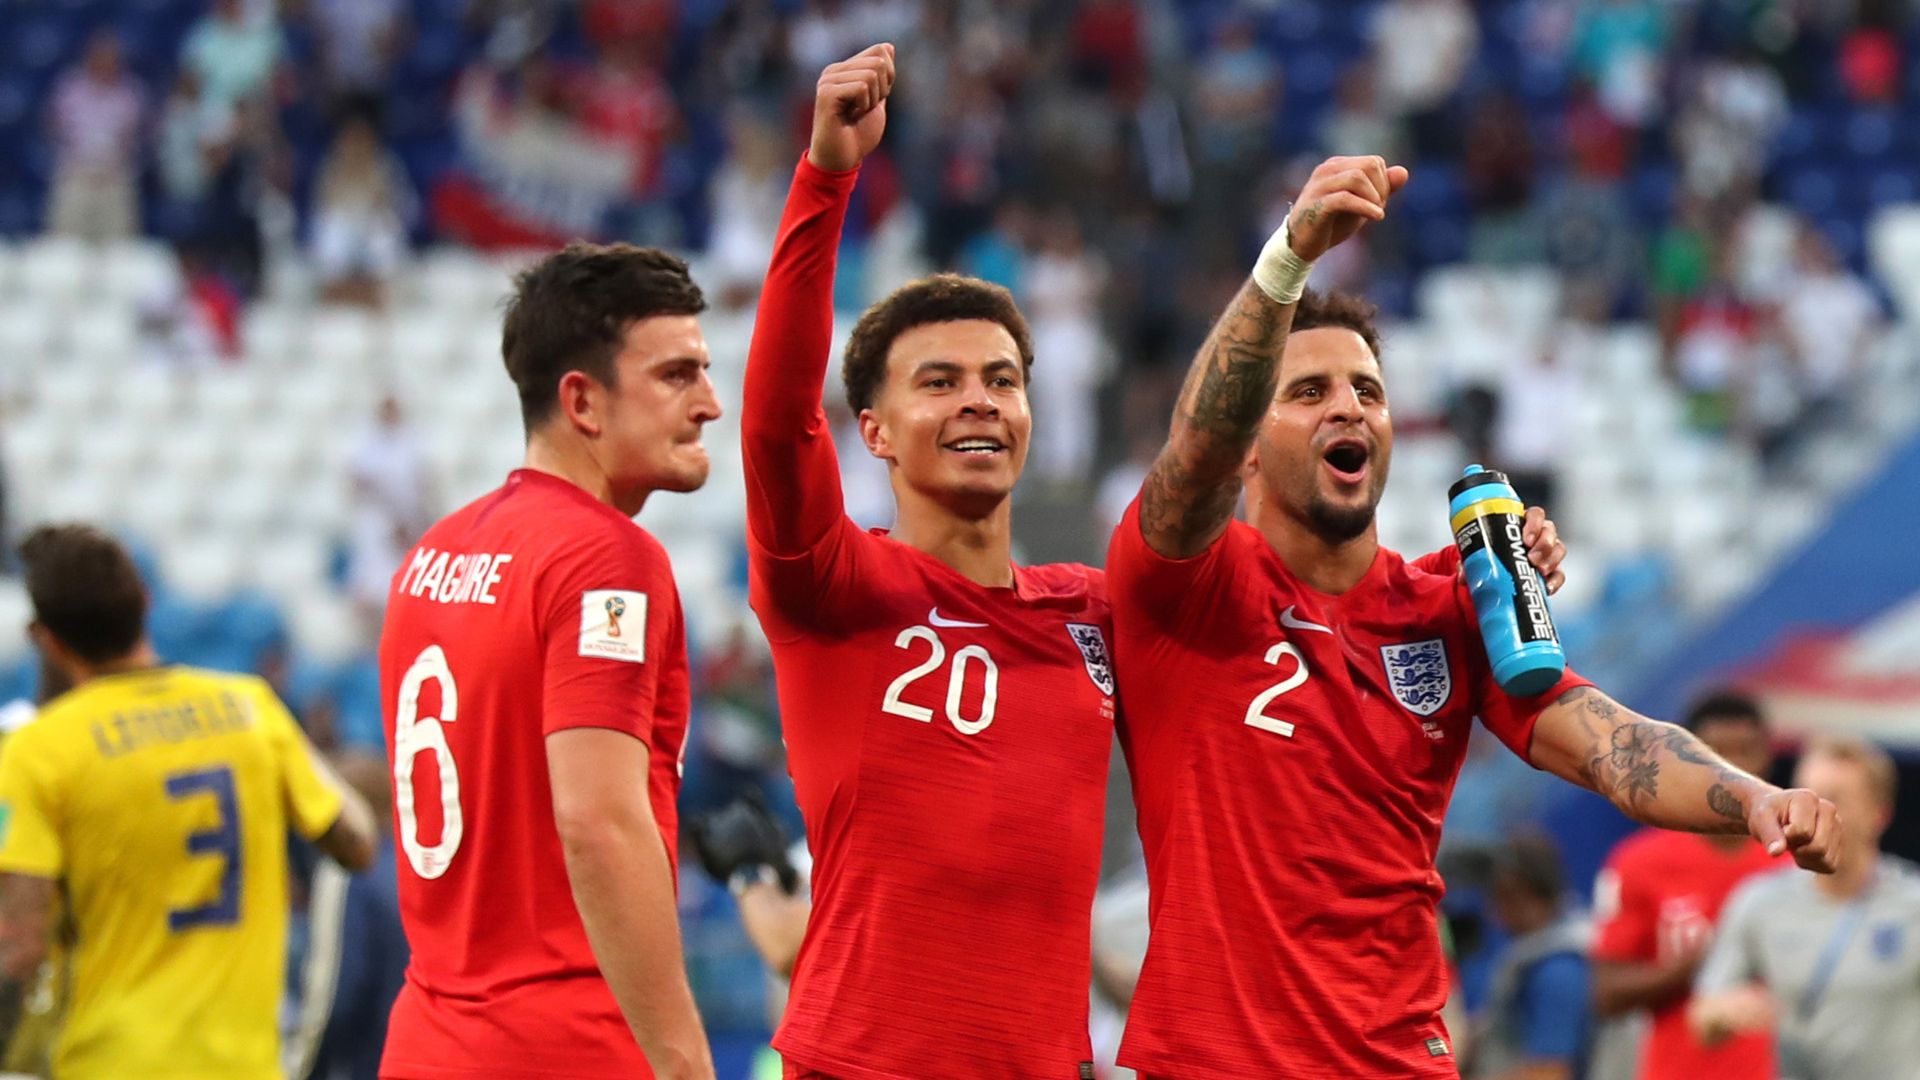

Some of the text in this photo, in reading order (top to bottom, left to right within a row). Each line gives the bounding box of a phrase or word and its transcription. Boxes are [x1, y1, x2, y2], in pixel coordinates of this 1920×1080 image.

[882, 624, 999, 735] 20
[1244, 641, 1310, 738] 2
[395, 644, 463, 880] 6
[164, 766, 243, 933] 3
